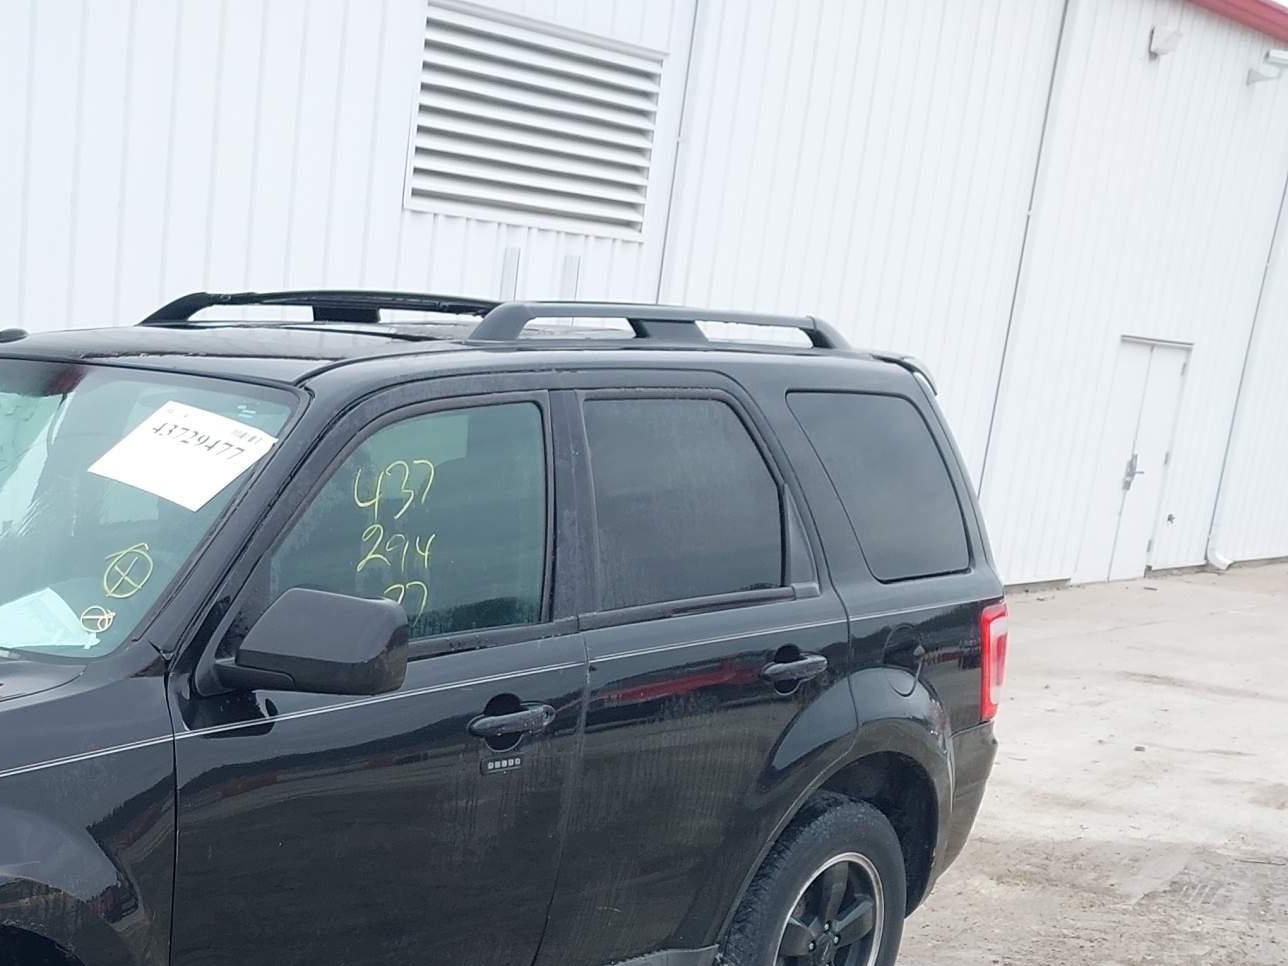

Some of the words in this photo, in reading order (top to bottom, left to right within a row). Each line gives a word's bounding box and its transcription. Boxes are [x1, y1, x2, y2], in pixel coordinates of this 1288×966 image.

[152, 422, 245, 460] 43729477
[354, 460, 435, 520] 437
[357, 524, 436, 572] 294
